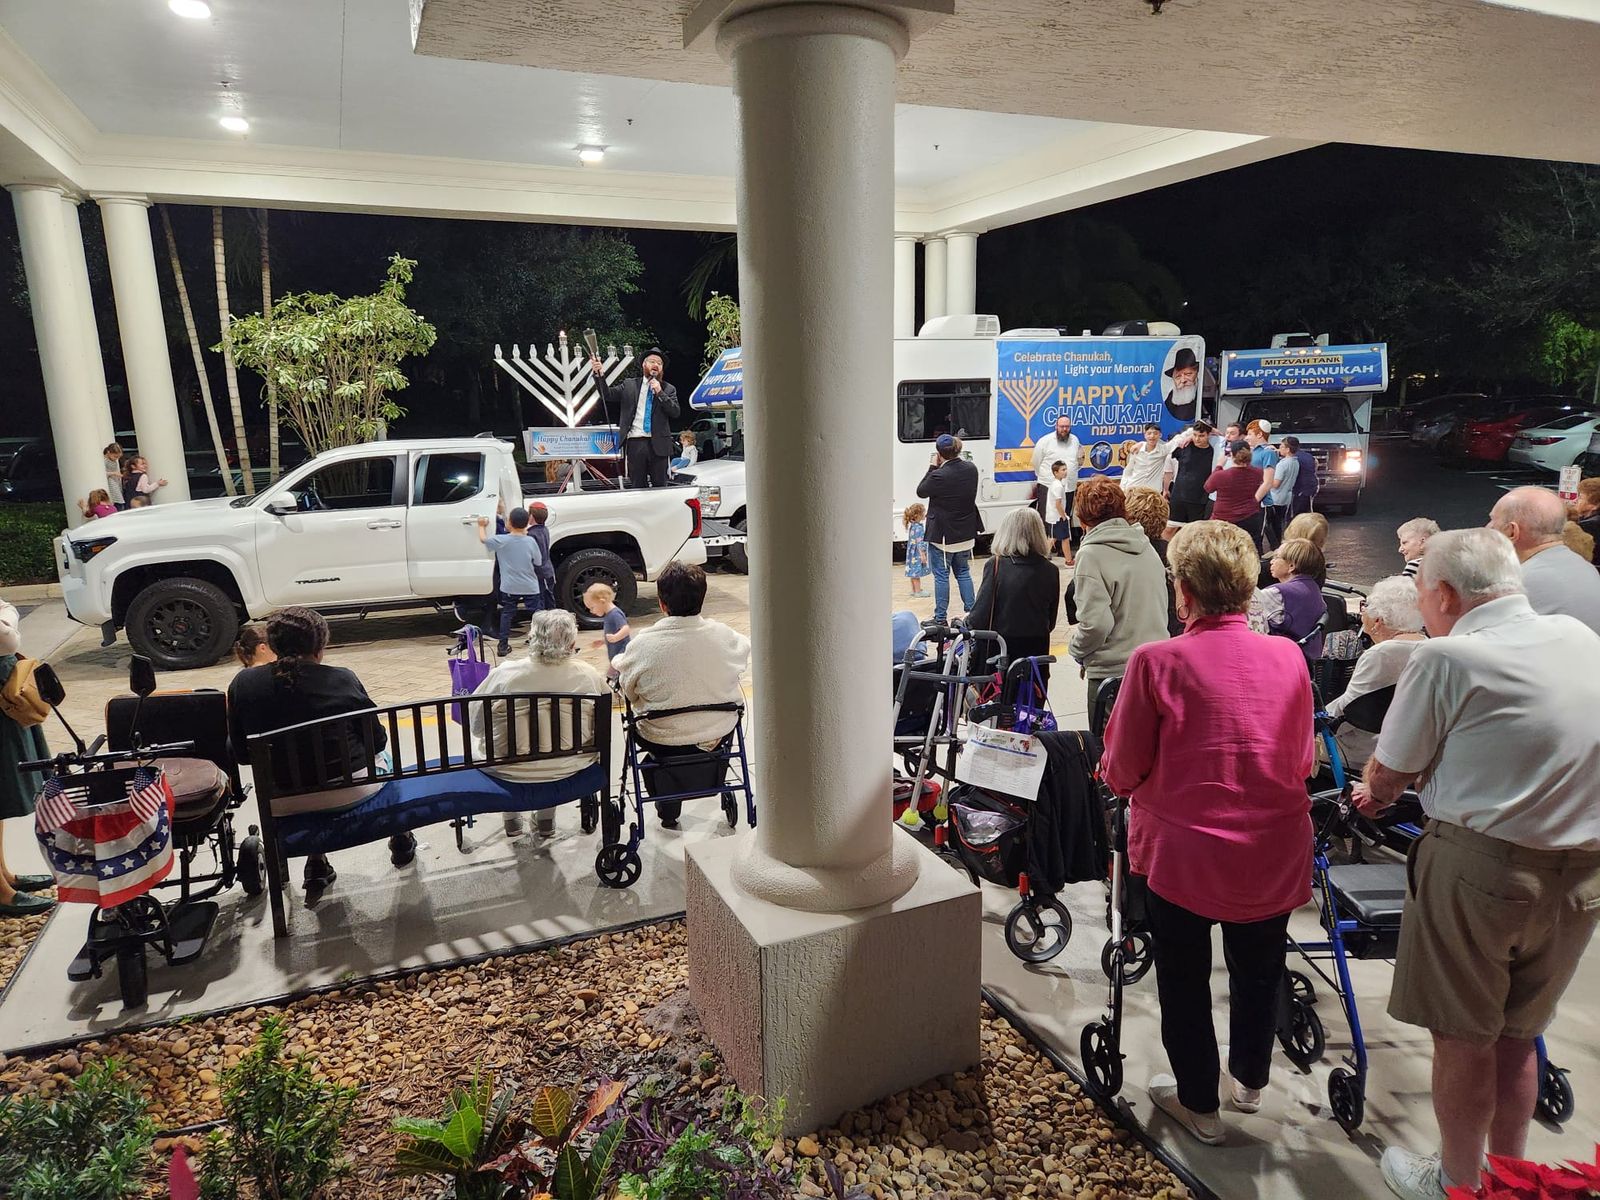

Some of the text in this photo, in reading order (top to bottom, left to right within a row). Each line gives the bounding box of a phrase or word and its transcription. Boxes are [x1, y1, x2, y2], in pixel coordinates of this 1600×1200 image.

[1014, 352, 1113, 363] Celebrate Chanukah,
[1264, 356, 1341, 366] MITZVAH TANK
[1065, 363, 1155, 377] Light your Menorah
[1233, 365, 1374, 378] HAPPY CHANUKAH
[1271, 377, 1334, 386] חנוכה שמח
[1058, 385, 1129, 406] HAPPY
[1091, 425, 1117, 436] שמח
